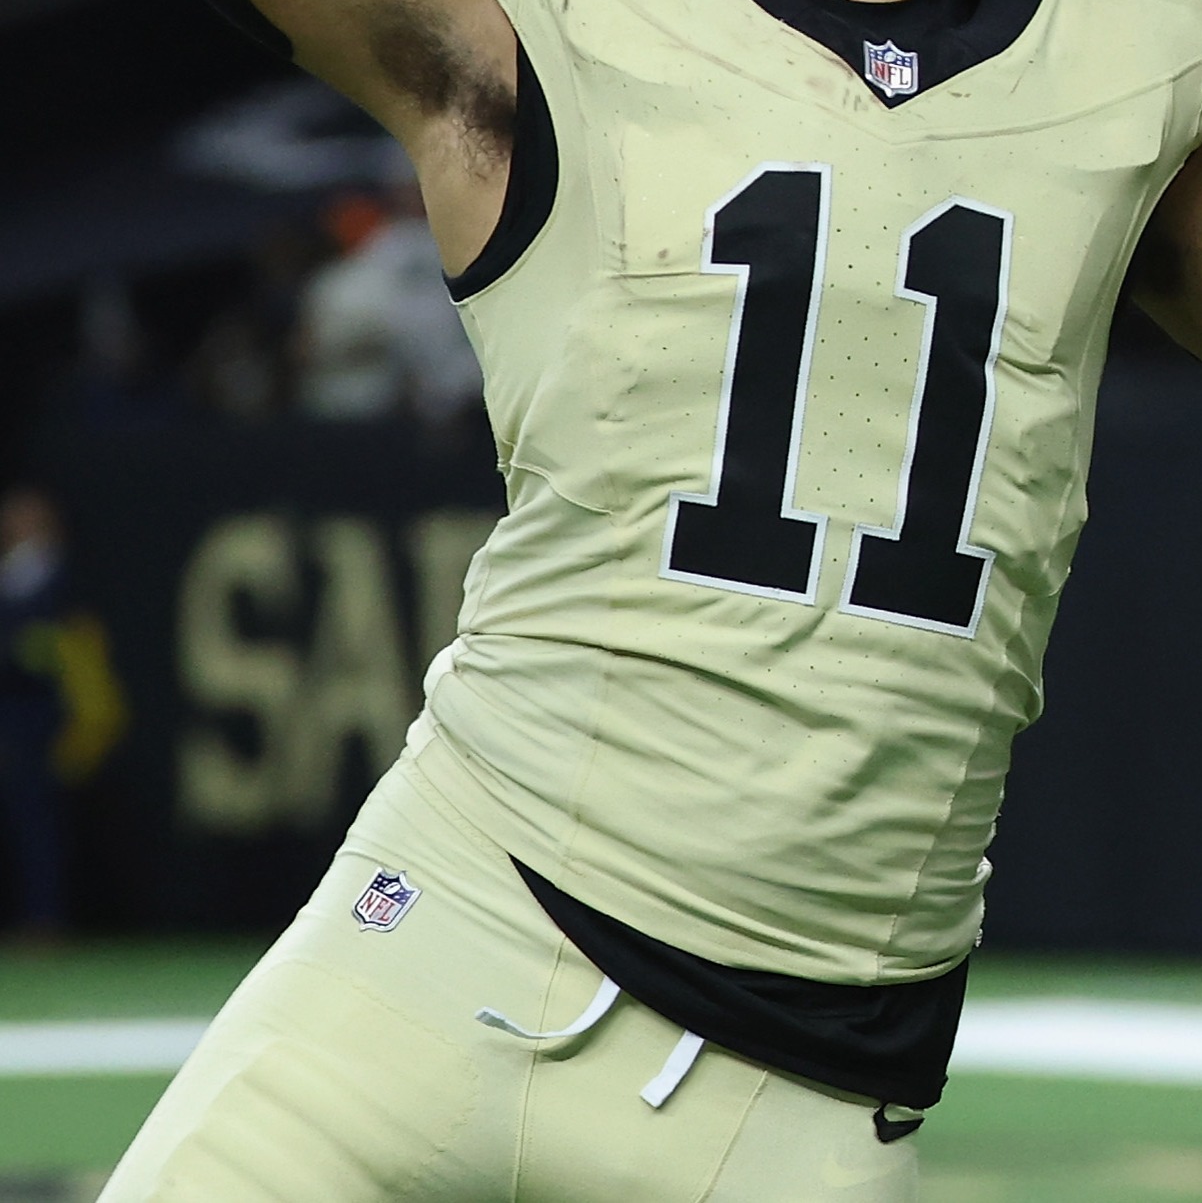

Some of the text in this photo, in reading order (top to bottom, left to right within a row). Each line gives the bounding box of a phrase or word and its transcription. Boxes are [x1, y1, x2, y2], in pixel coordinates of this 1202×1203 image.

[873, 60, 909, 86] NFL
[658, 159, 1016, 640] 11
[360, 891, 396, 922] NFL
